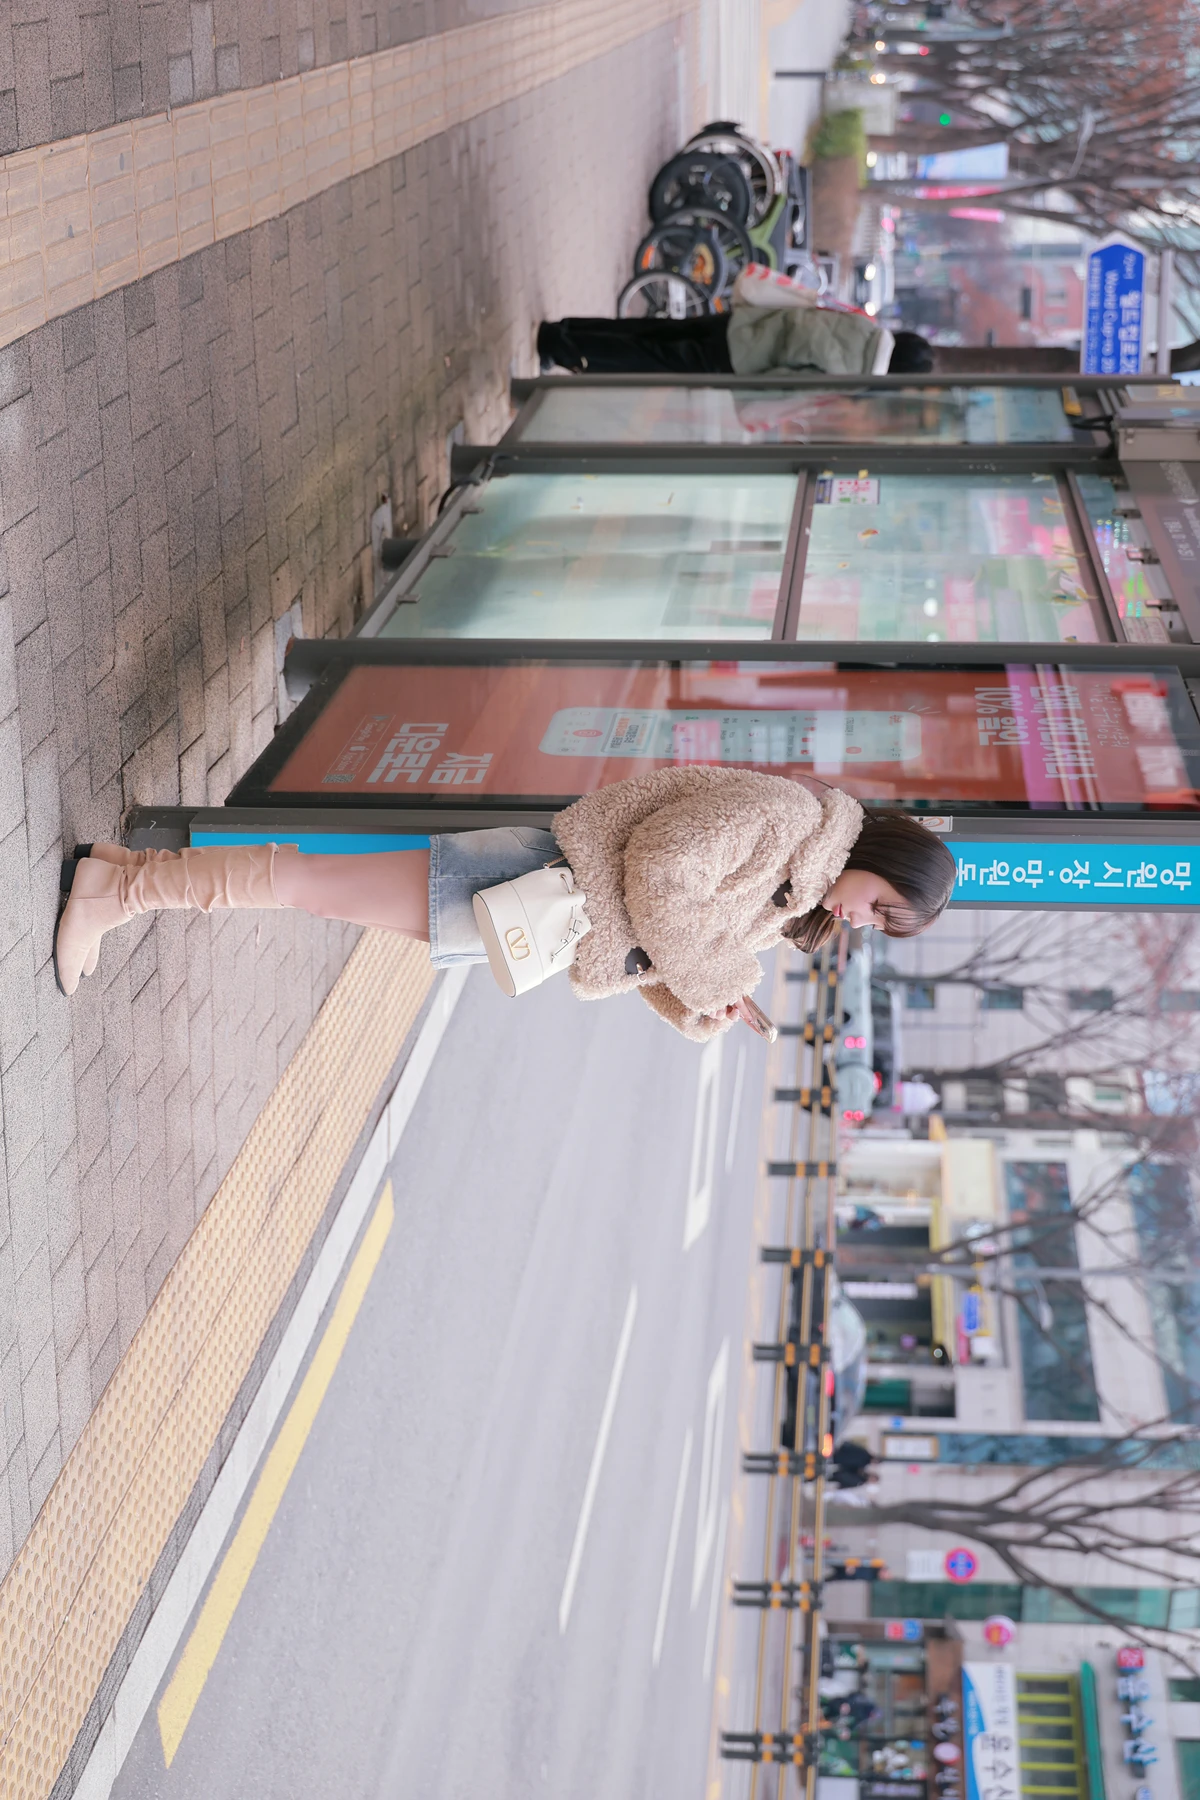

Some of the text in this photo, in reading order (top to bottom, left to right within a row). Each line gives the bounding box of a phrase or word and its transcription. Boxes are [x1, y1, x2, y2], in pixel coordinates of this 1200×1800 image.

[1103, 269, 1119, 309] World
[974, 685, 1030, 746] 10% 할인
[365, 722, 450, 784] 다운로드
[427, 752, 494, 785] 지금
[1036, 717, 1098, 780] 어디서나
